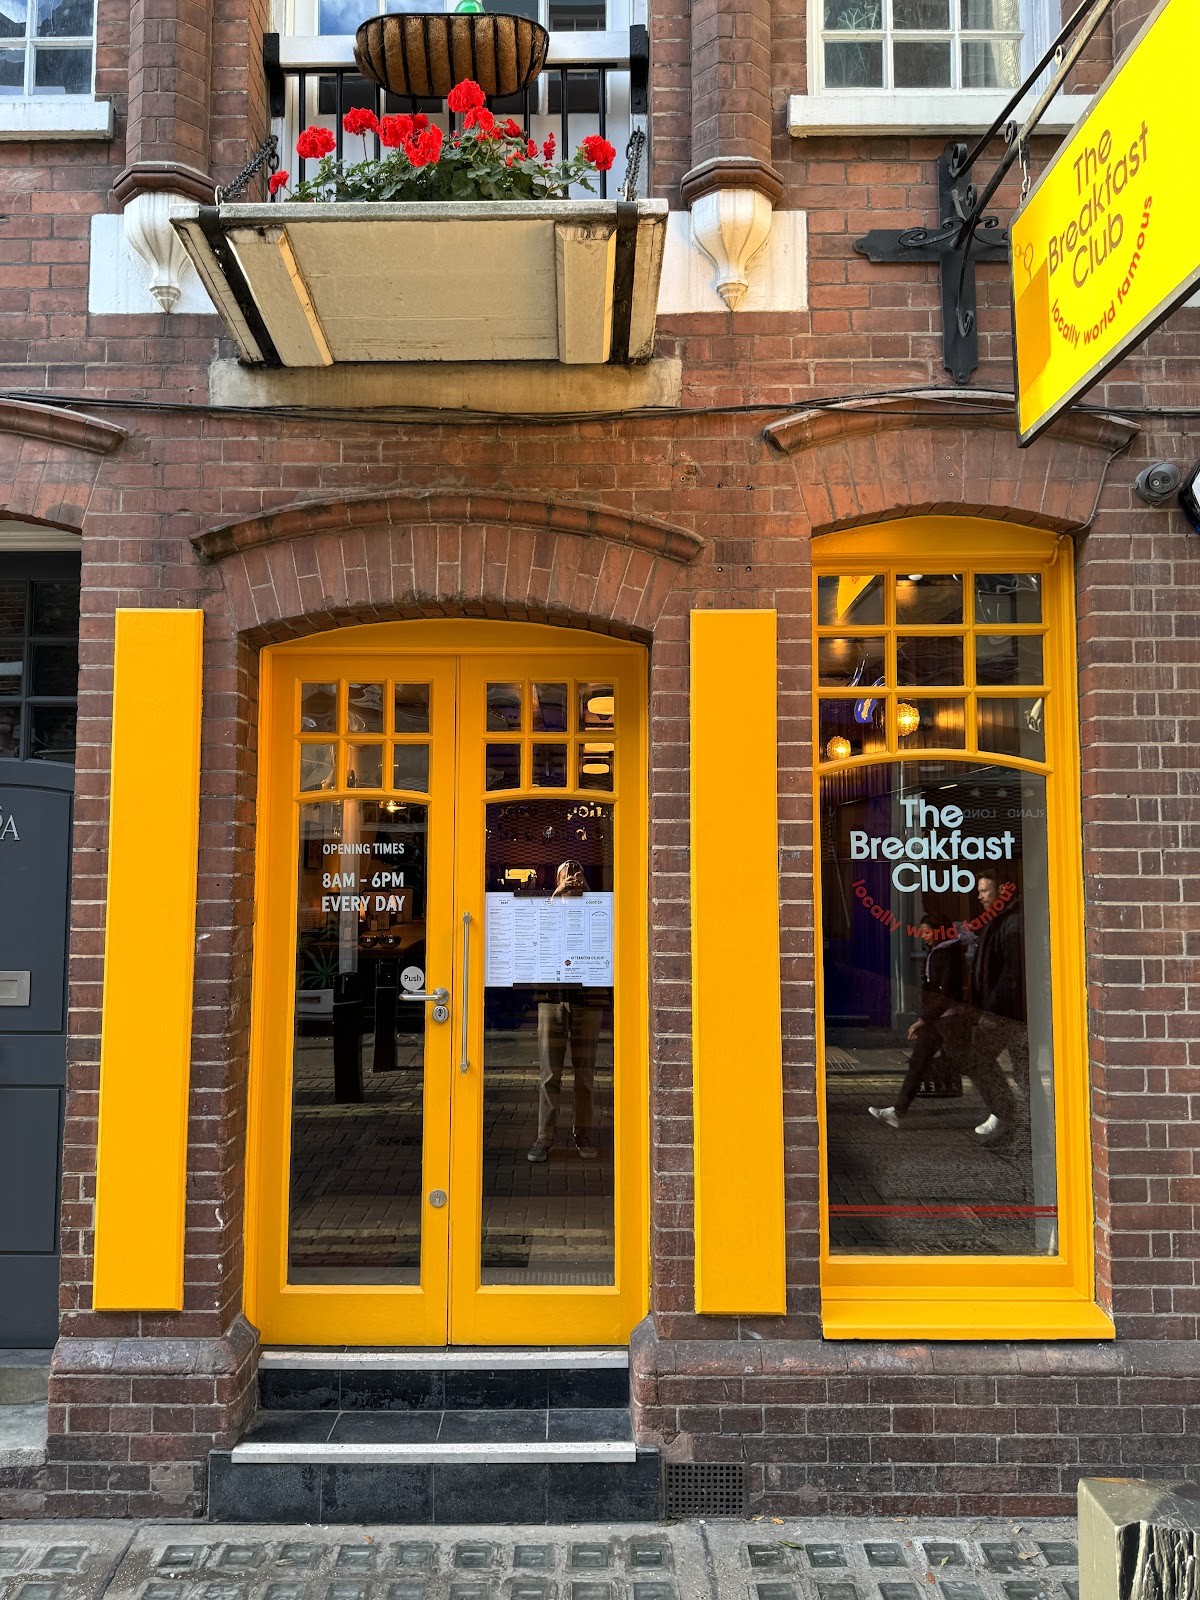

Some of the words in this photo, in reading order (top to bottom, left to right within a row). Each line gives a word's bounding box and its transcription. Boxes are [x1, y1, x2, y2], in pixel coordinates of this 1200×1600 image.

[1073, 129, 1112, 196] The
[1048, 120, 1148, 277] Breakfast
[1073, 212, 1123, 289] Club
[1051, 298, 1081, 350] locally
[1083, 304, 1116, 346] world
[1117, 195, 1152, 305] famous
[899, 799, 963, 829] The
[322, 844, 371, 855] OPENING
[373, 843, 405, 854] TIMES
[850, 830, 1015, 861] Breakfast
[322, 873, 355, 888] 8AM
[371, 872, 404, 888] 6PM
[892, 863, 976, 893] Club
[321, 896, 371, 912] EVERY
[375, 895, 406, 912] DAY
[852, 879, 902, 932] locally
[905, 922, 959, 941] world
[961, 881, 1017, 933] famous
[404, 974, 422, 982] Push
